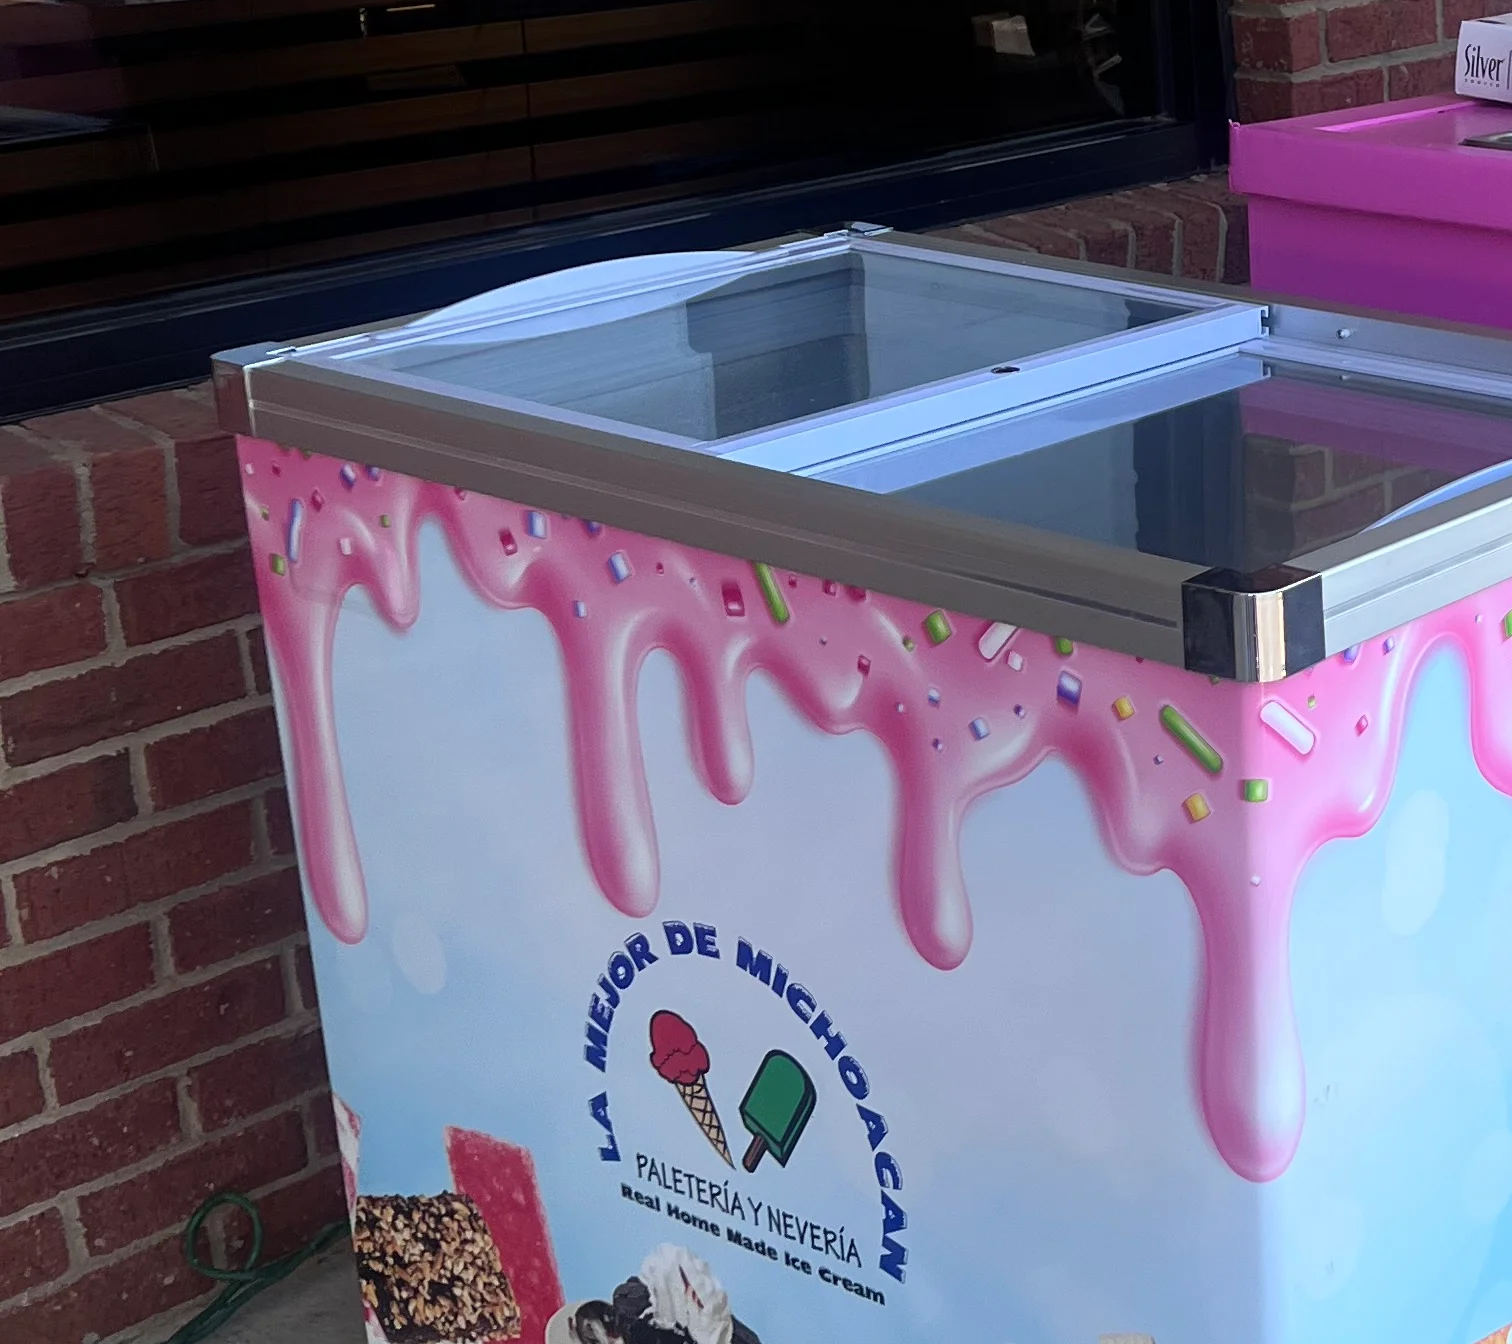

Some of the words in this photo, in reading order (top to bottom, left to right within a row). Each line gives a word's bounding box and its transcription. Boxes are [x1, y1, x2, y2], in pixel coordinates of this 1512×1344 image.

[1464, 43, 1505, 82] Silver
[662, 920, 721, 960] DE
[583, 932, 659, 1073] MEJOR
[588, 1090, 621, 1163] LA
[735, 936, 909, 1284] MICHOACAN
[621, 1182, 661, 1213] Real
[666, 1202, 721, 1237] Home
[727, 1227, 778, 1261] Made
[784, 1251, 813, 1275] Ice
[818, 1266, 886, 1306] Cream
[636, 1152, 746, 1221] PALETERÍA
[748, 1196, 762, 1226] Y
[767, 1202, 863, 1269] NEVERÍA
